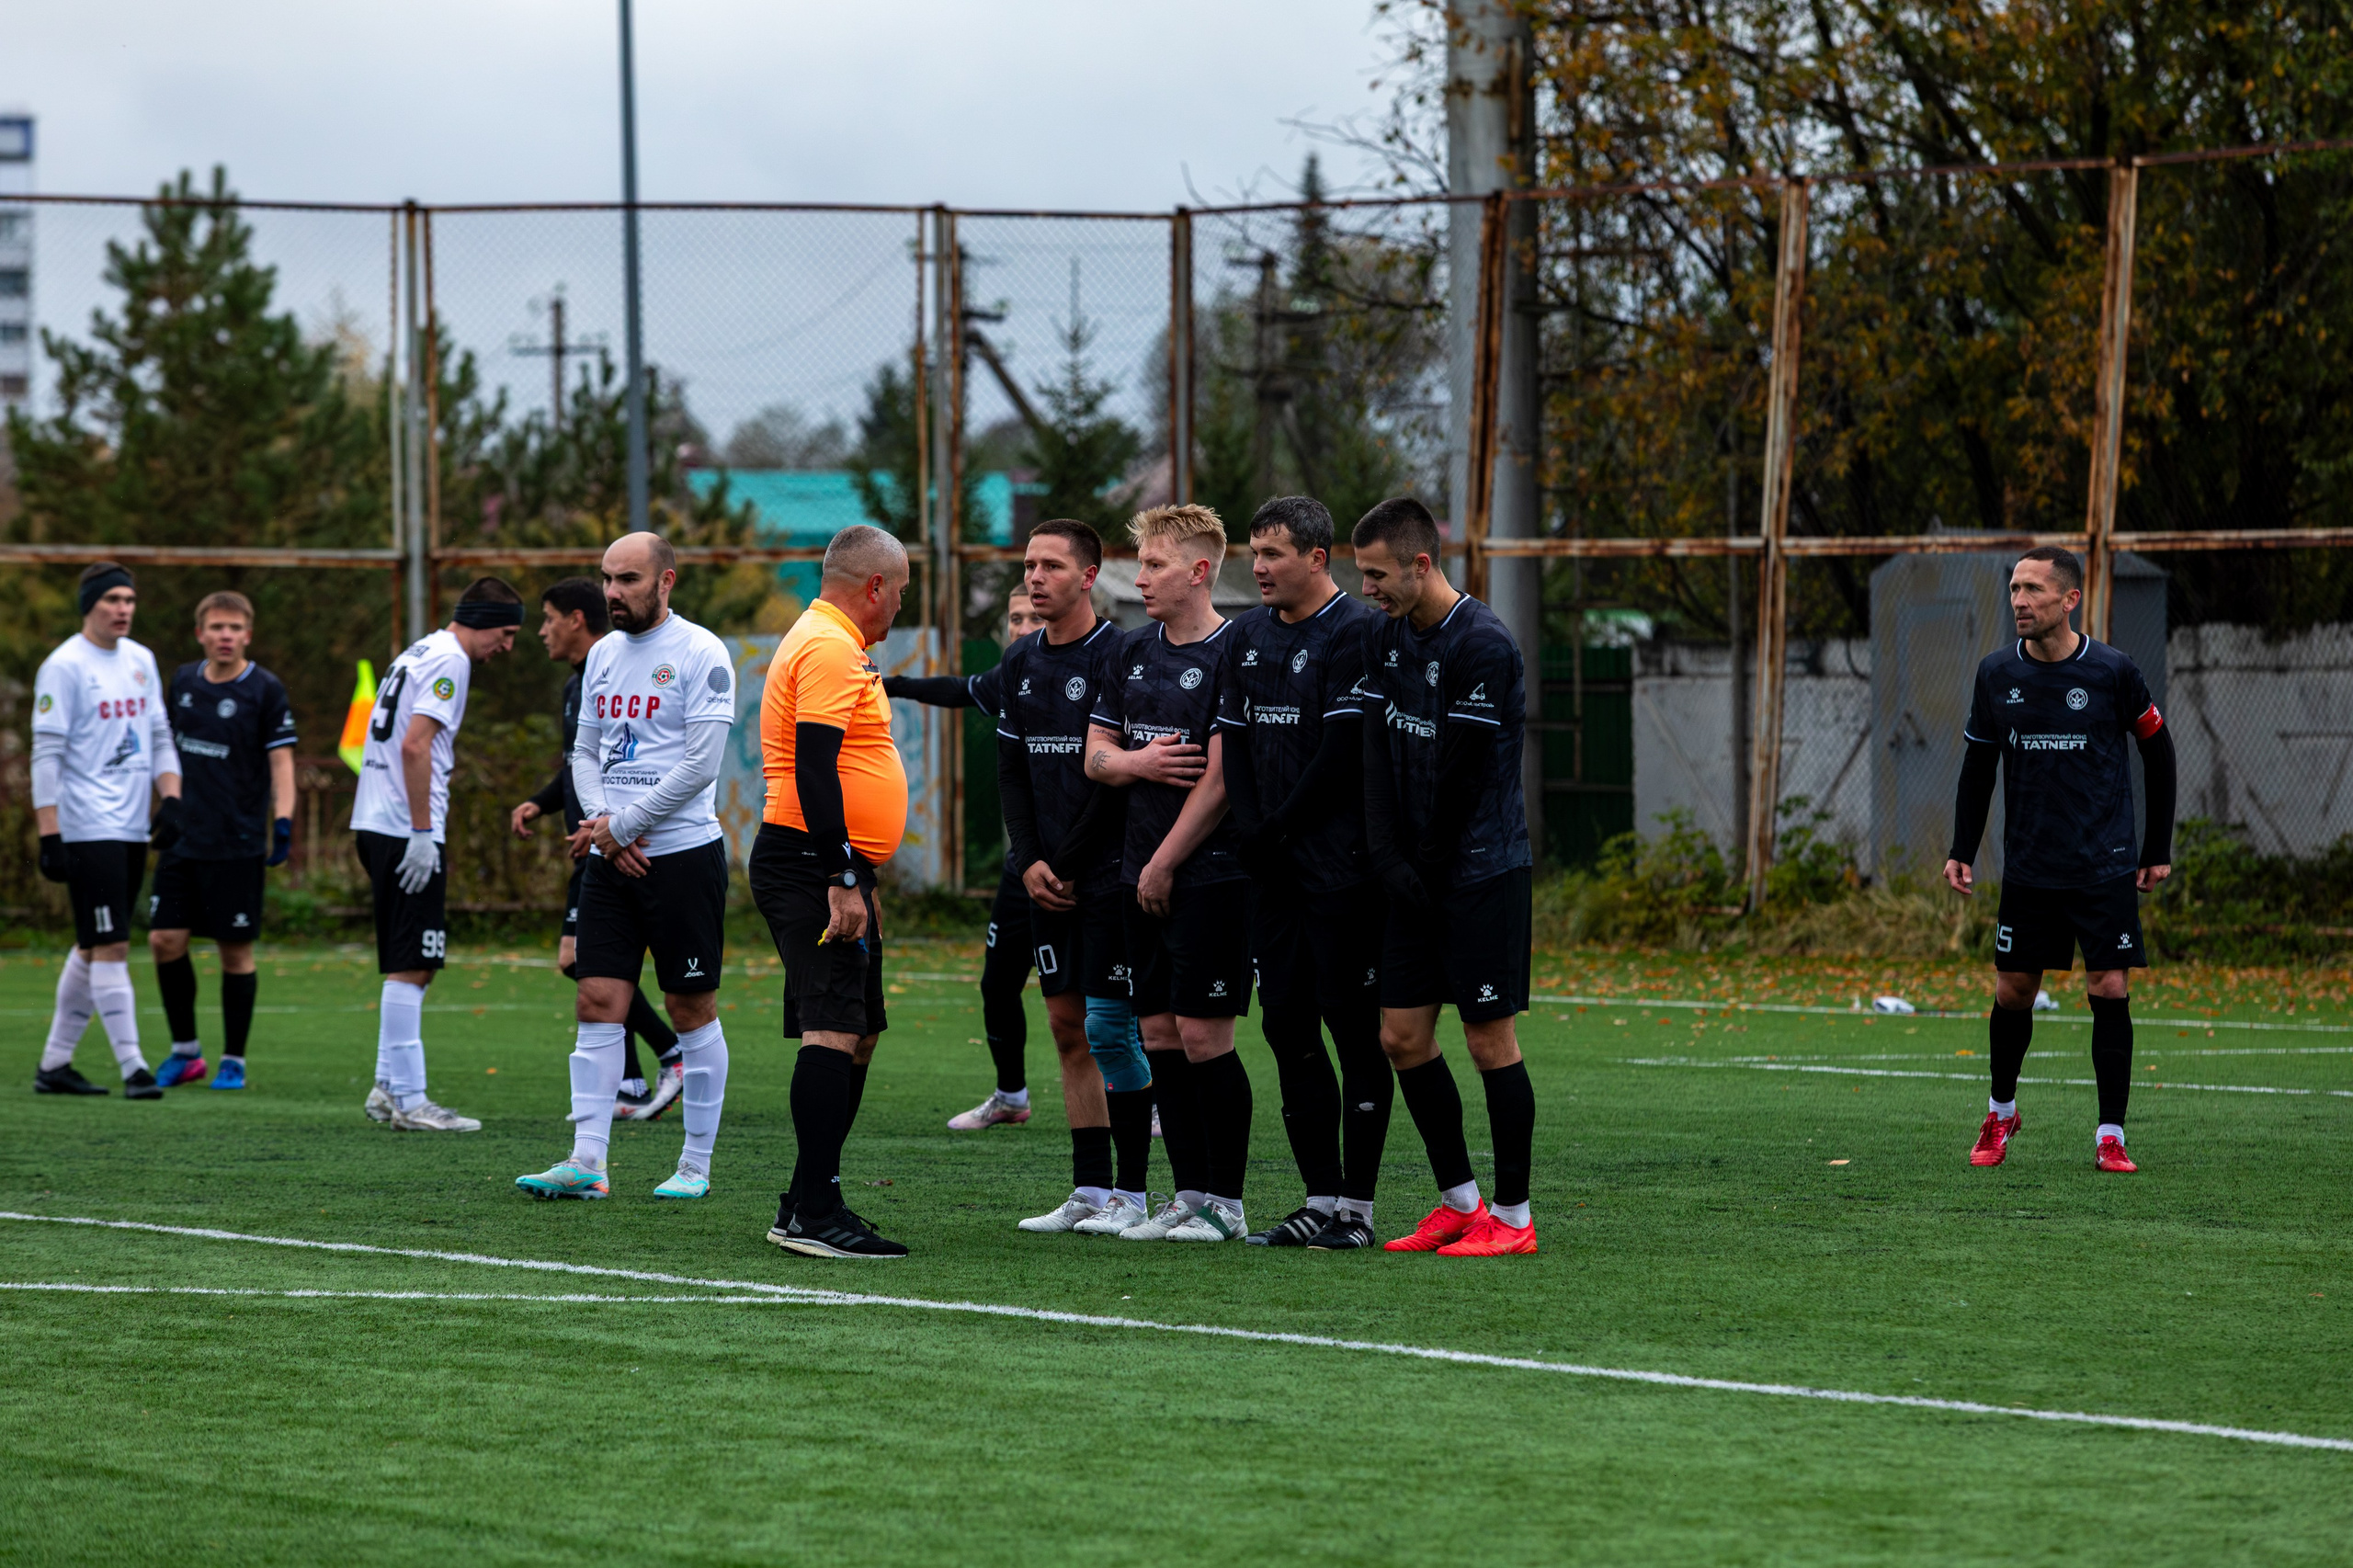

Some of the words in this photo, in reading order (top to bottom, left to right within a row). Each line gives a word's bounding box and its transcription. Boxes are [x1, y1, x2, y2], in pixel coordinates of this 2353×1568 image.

[597, 695, 660, 719] СССР
[1027, 743, 1083, 754] TATNEFT
[2021, 740, 2087, 750] TATNEFT
[95, 905, 114, 933] 11
[1477, 994, 1499, 1003] KELME
